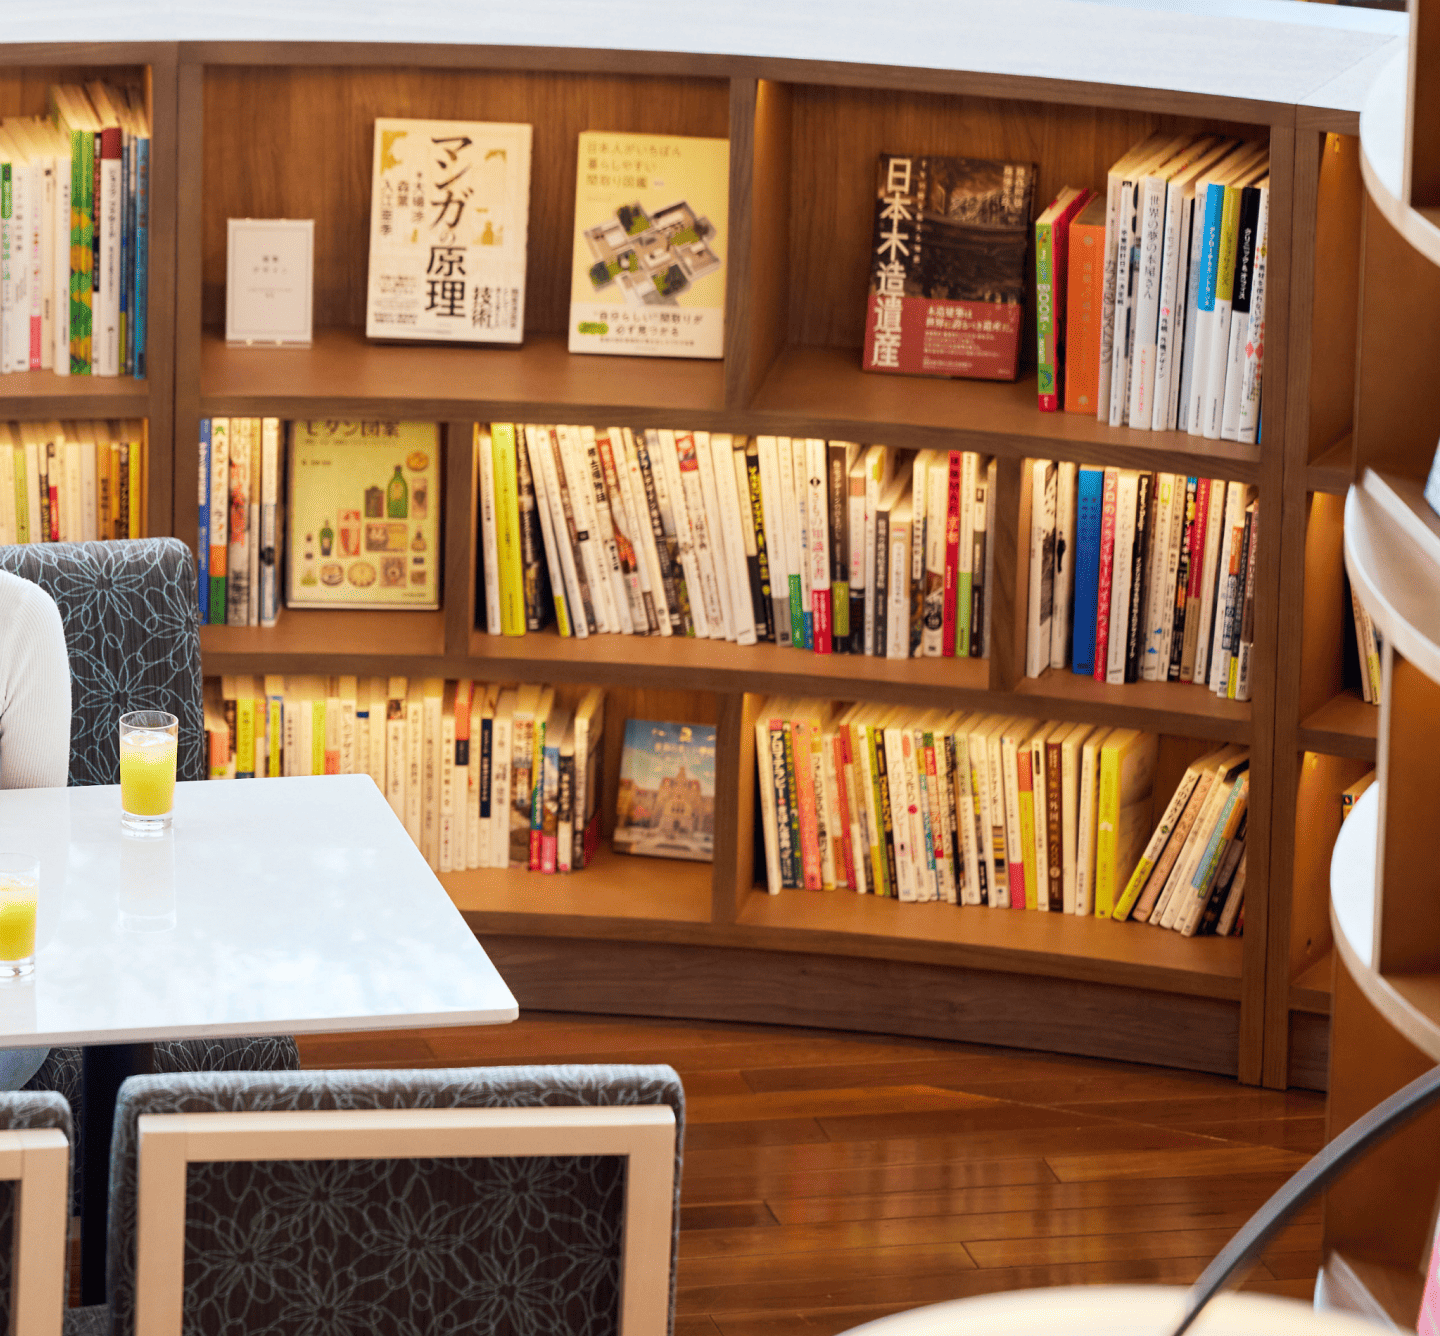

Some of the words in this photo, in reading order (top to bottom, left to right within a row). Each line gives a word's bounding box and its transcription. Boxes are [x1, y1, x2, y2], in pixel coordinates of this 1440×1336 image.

[424, 135, 475, 318] マンガの原理
[872, 158, 912, 368] 日本木造遺産
[1142, 194, 1159, 300] 世界の夢の本屋さん
